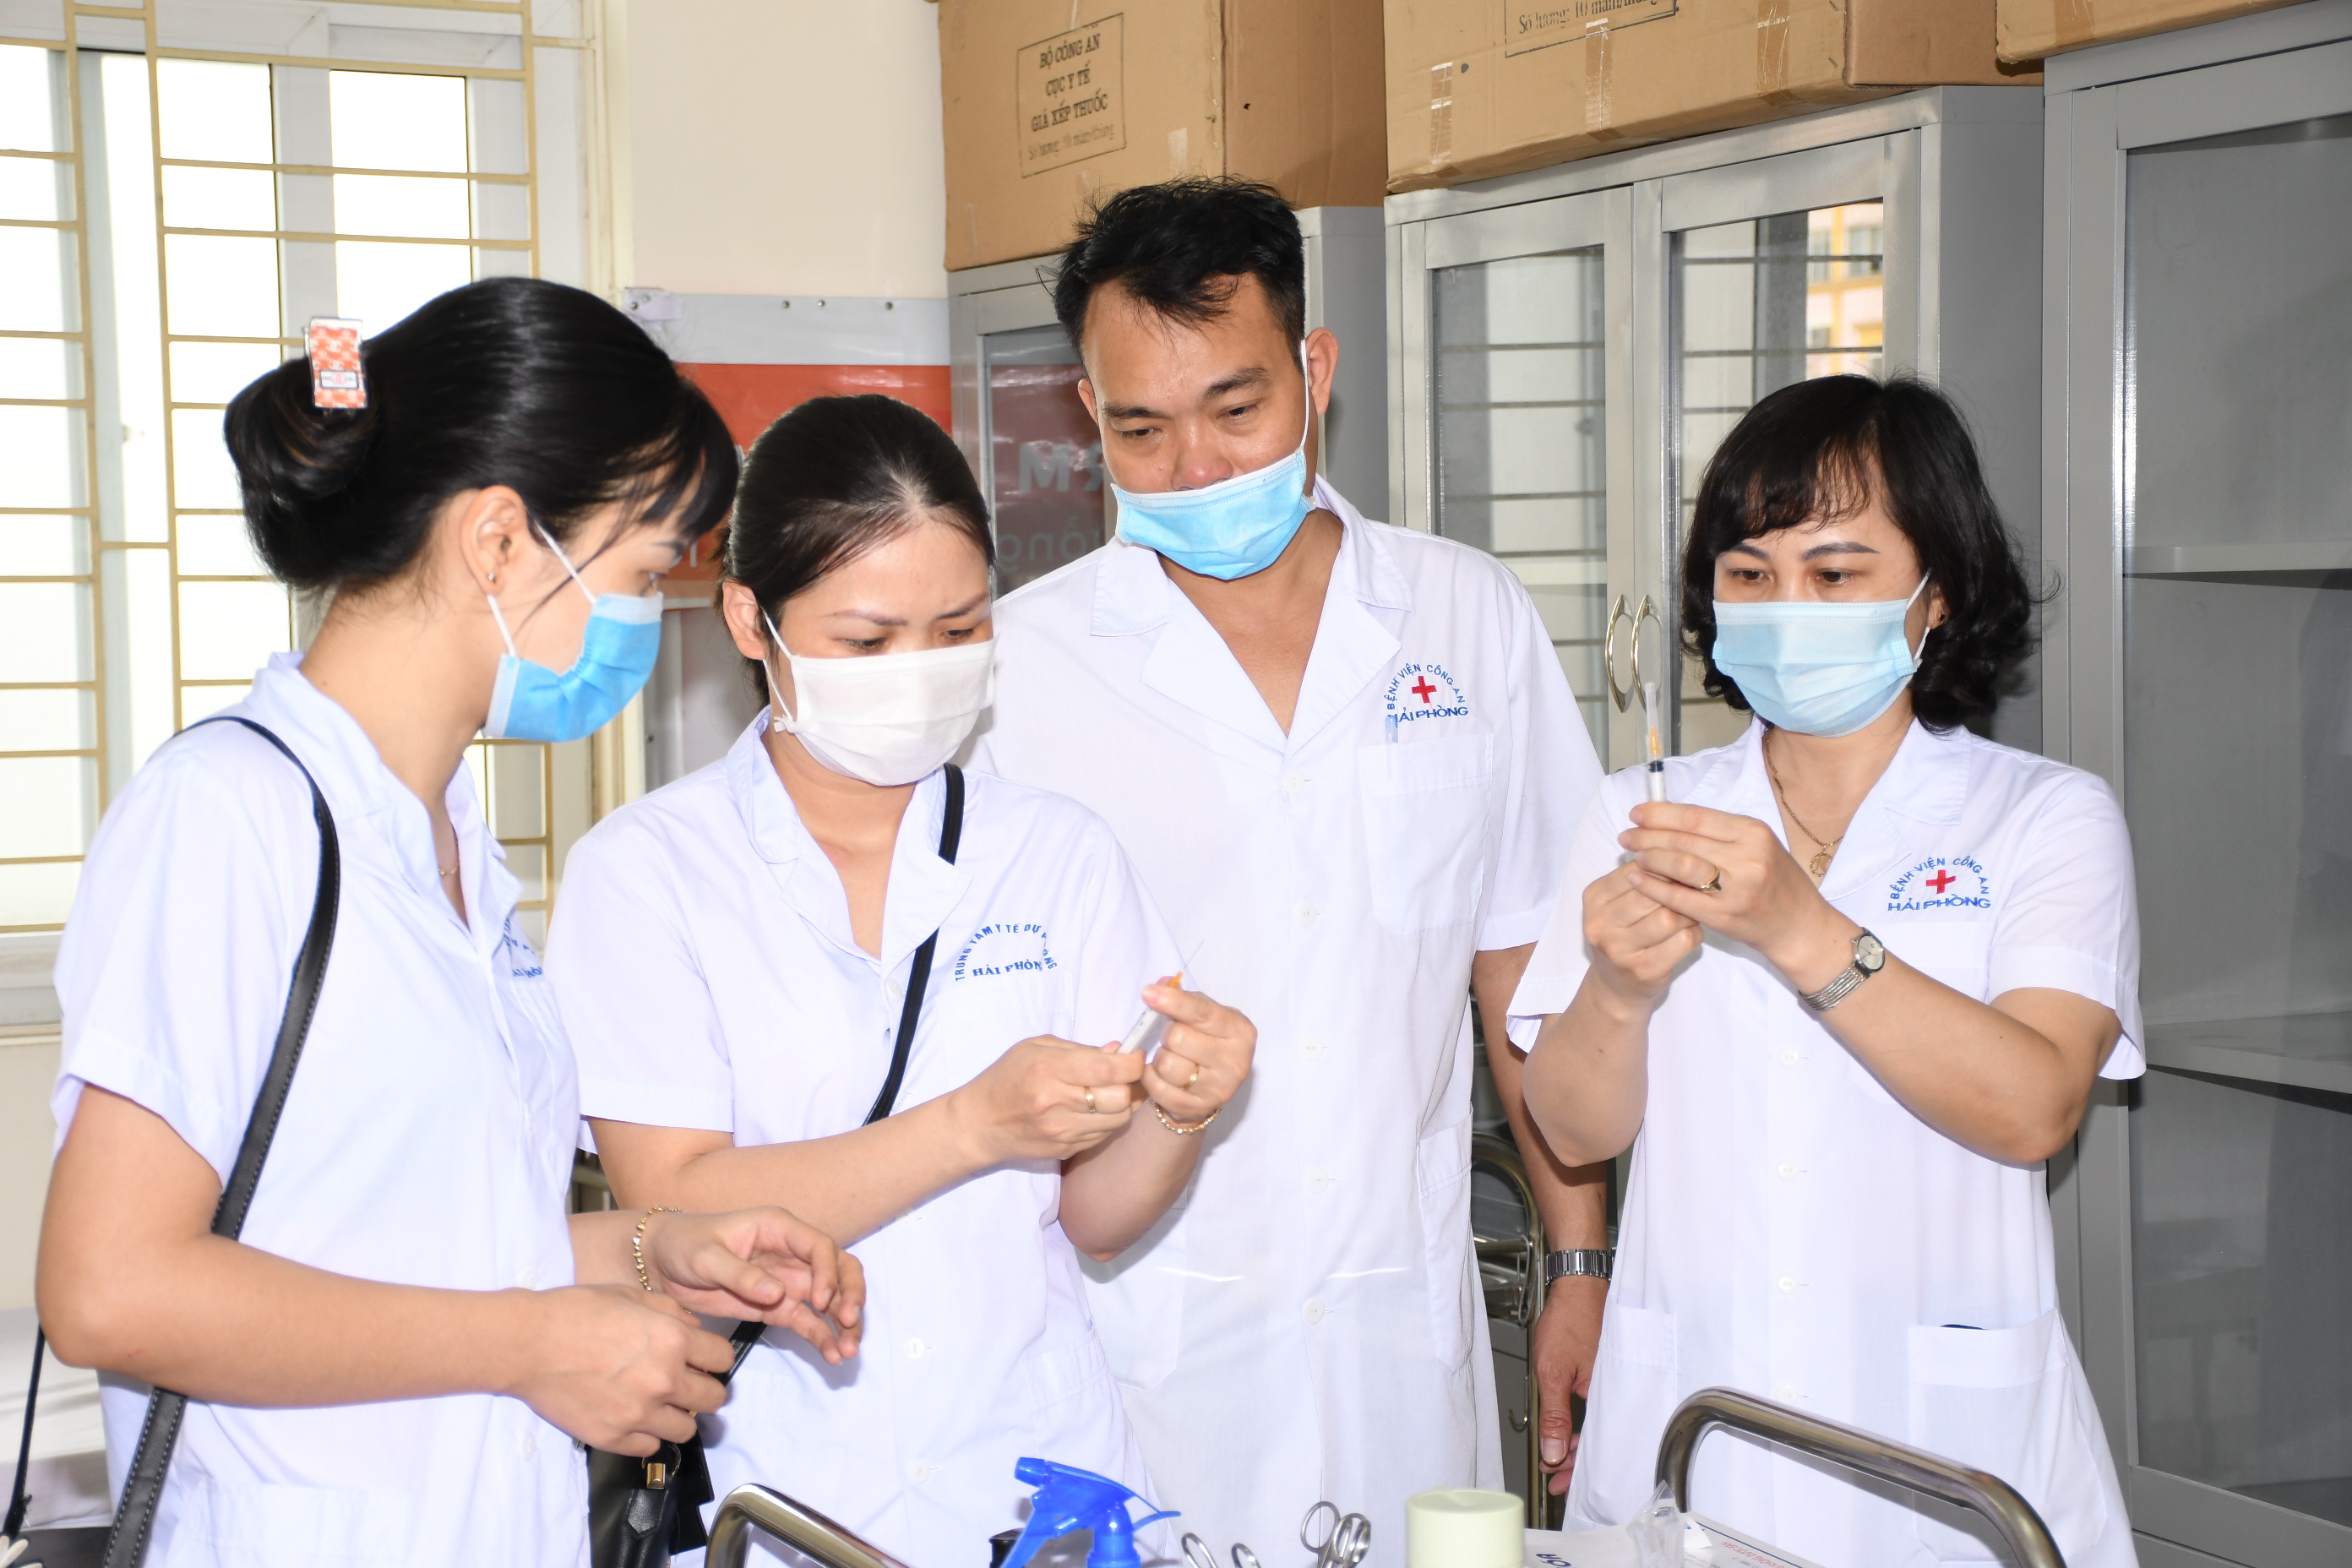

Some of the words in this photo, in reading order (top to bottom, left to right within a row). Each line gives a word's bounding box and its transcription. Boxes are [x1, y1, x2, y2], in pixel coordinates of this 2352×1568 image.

[1576, 1, 1587, 18] 10
[1039, 45, 1054, 69] BỘ
[1054, 40, 1082, 63] CÔNG
[1085, 33, 1101, 53] AN
[1045, 75, 1065, 98] CỤC
[1067, 73, 1075, 90] Y
[1077, 59, 1091, 86] TẾ
[1051, 99, 1071, 126] XẾP
[1073, 88, 1108, 118] THUỐC
[1384, 676, 1400, 710] BỆNH
[1397, 663, 1422, 678] VIỆN
[1426, 664, 1454, 685] CÔNG
[1452, 688, 1465, 703] AN
[1415, 705, 1469, 718] PHÒNG
[1889, 870, 1914, 900] BỆNH
[1914, 857, 1946, 872] VIỆN
[1978, 876, 1990, 895] AN
[1888, 897, 1920, 912] HẢI
[1923, 893, 1991, 908] PHÒNG
[955, 948, 972, 982] TRUNG
[995, 923, 1001, 933] Y
